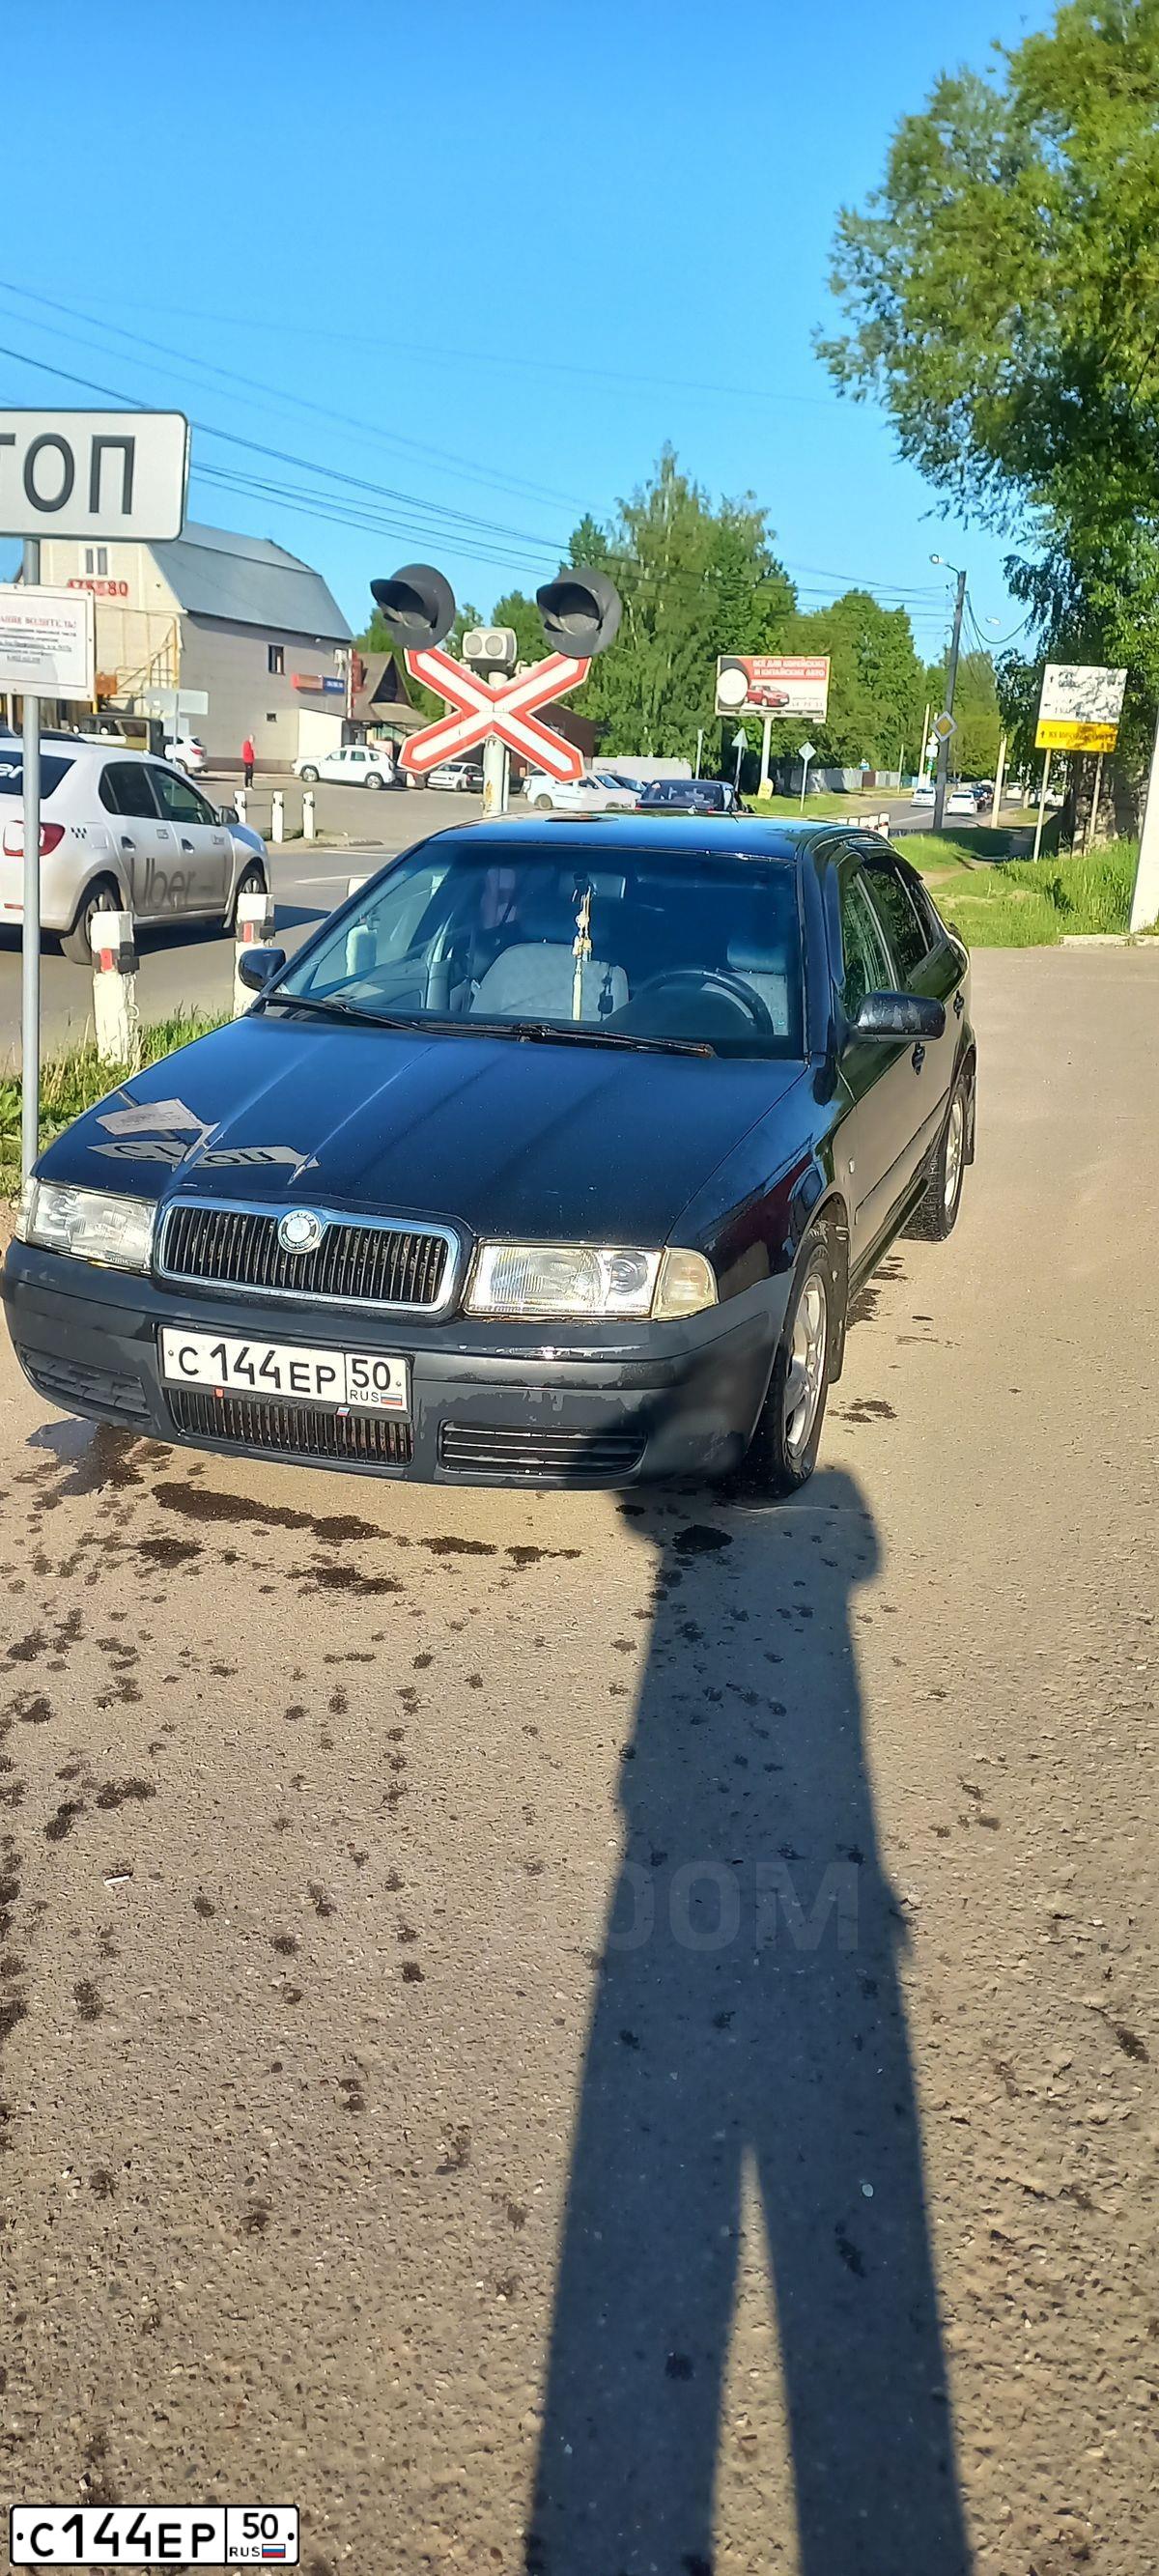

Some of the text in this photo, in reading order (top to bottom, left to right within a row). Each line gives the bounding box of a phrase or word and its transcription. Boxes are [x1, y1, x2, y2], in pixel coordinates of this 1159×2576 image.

[130, 857, 196, 909] Uber
[352, 1358, 390, 1391] 50
[350, 1389, 380, 1402] RUS
